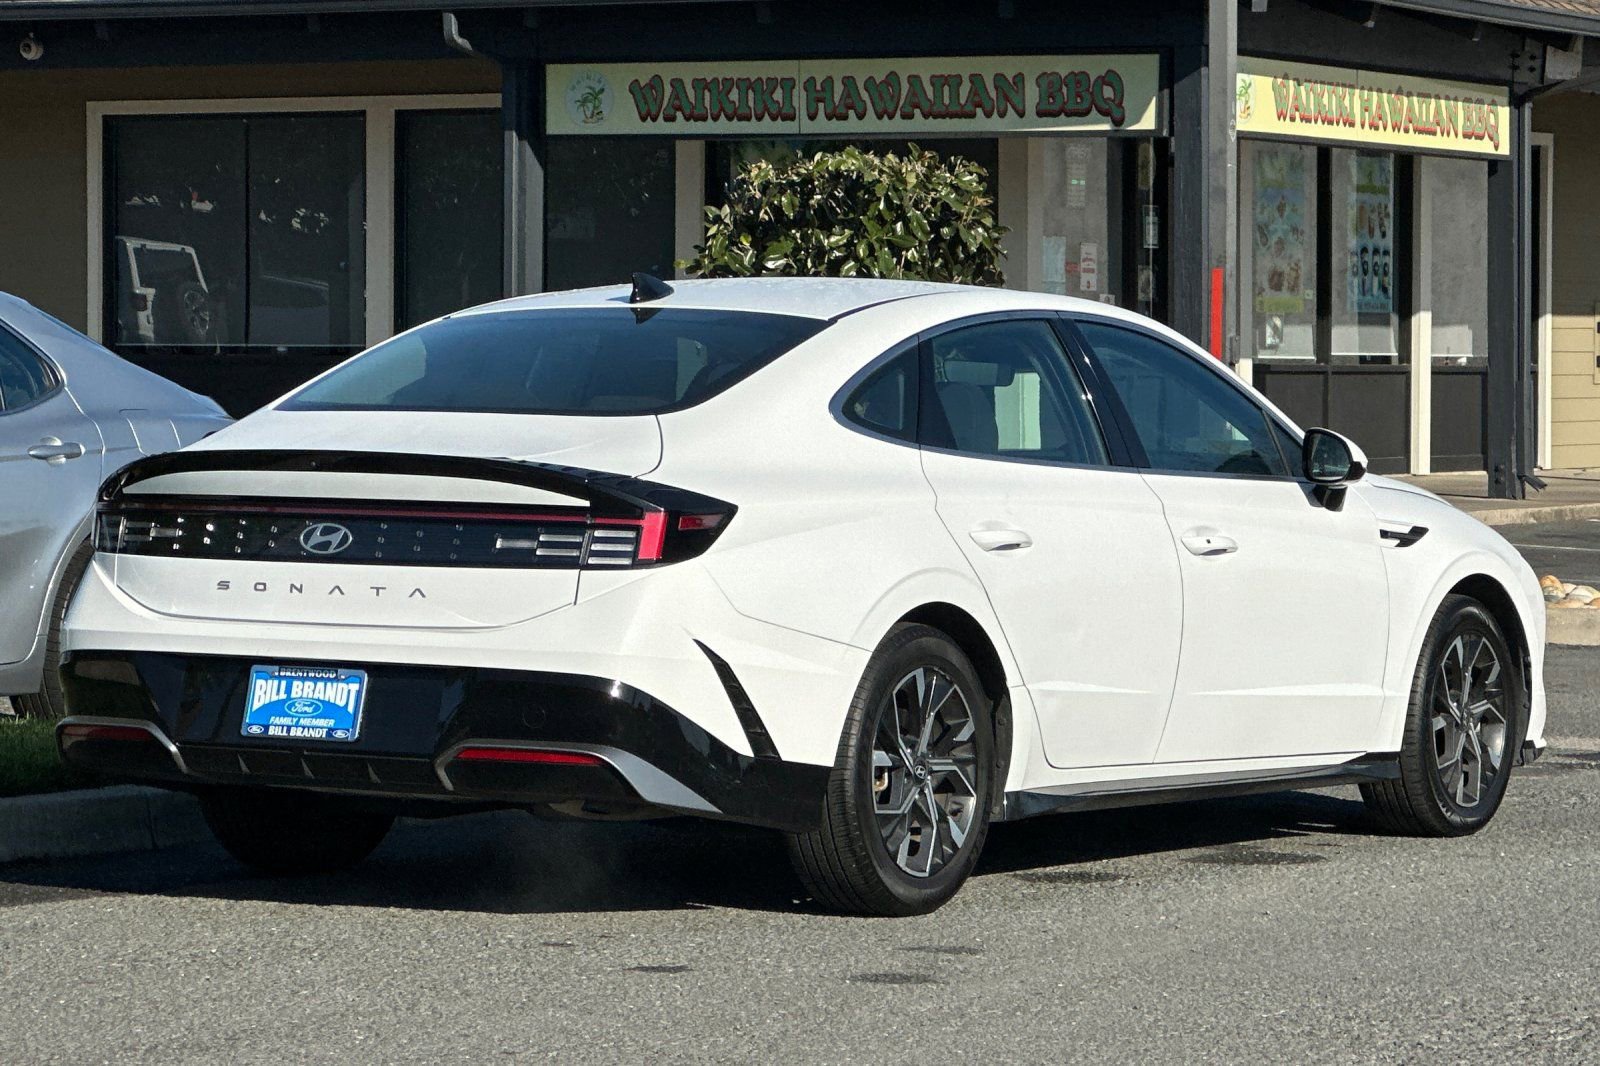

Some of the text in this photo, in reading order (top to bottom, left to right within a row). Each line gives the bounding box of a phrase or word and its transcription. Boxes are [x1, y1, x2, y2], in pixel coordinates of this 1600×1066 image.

[628, 74, 797, 123] WAIKIKI
[804, 70, 1026, 121] HAWAIIAN
[1036, 69, 1125, 127] BBQ
[1272, 72, 1500, 151] WAIKIKI HAWAIIAN BBQ
[216, 580, 426, 598] SONATA
[252, 679, 360, 715] BILL BRANDT
[291, 700, 315, 713] Ford
[269, 716, 335, 727] FAMILY MEMBER
[268, 725, 289, 736] BILL
[290, 727, 328, 738] BRANDT
